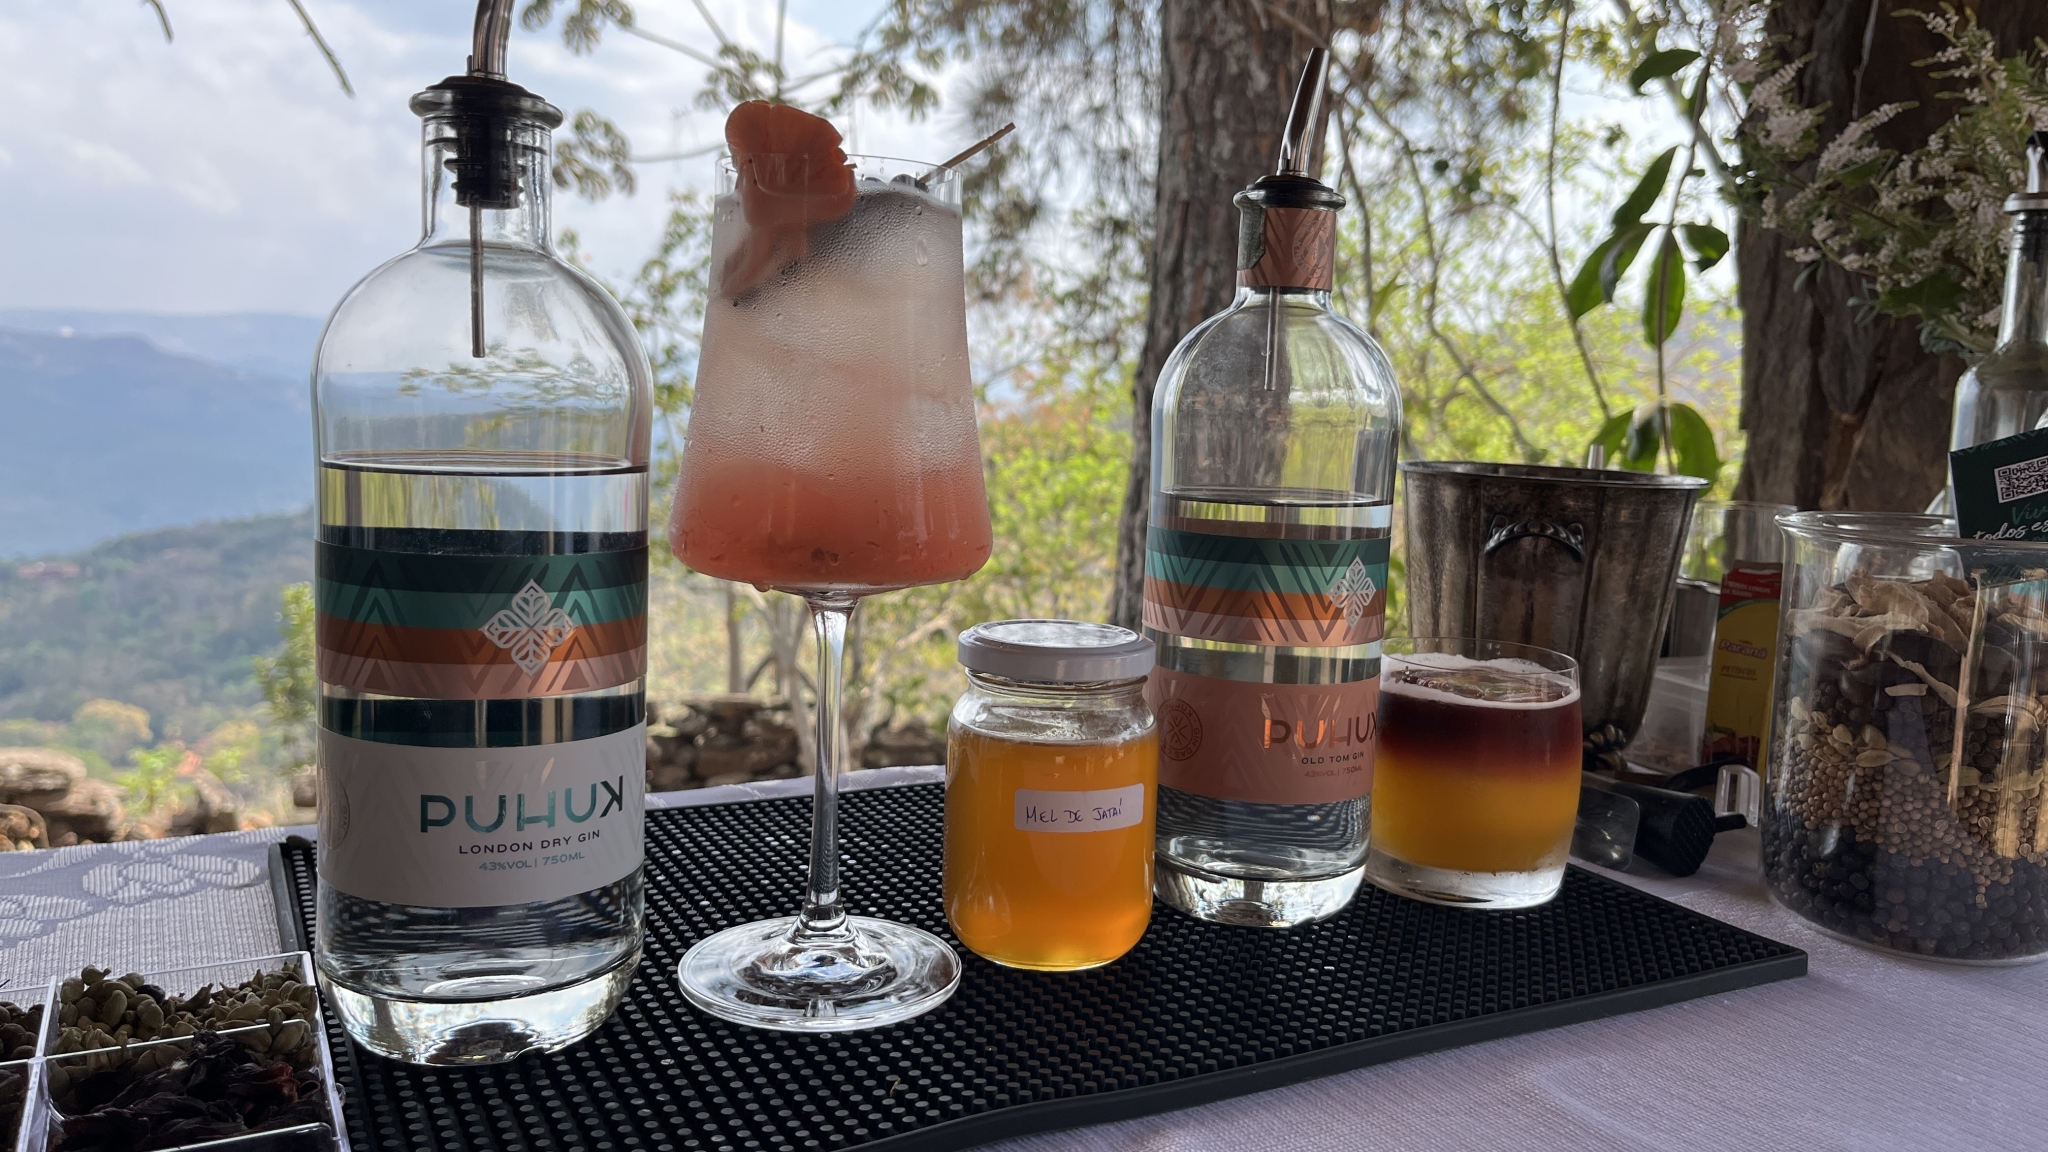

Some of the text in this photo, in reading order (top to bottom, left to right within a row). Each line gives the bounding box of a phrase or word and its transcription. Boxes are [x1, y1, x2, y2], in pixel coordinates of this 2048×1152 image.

[1973, 522, 2028, 540] todos
[1301, 751, 1365, 765] OLD TOM GIN
[420, 775, 624, 833] PUHUK
[1026, 805, 1058, 824] MEL
[1063, 809, 1083, 823] DE
[459, 829, 600, 855] LONDON DRY GIN
[542, 851, 585, 866] 750ML
